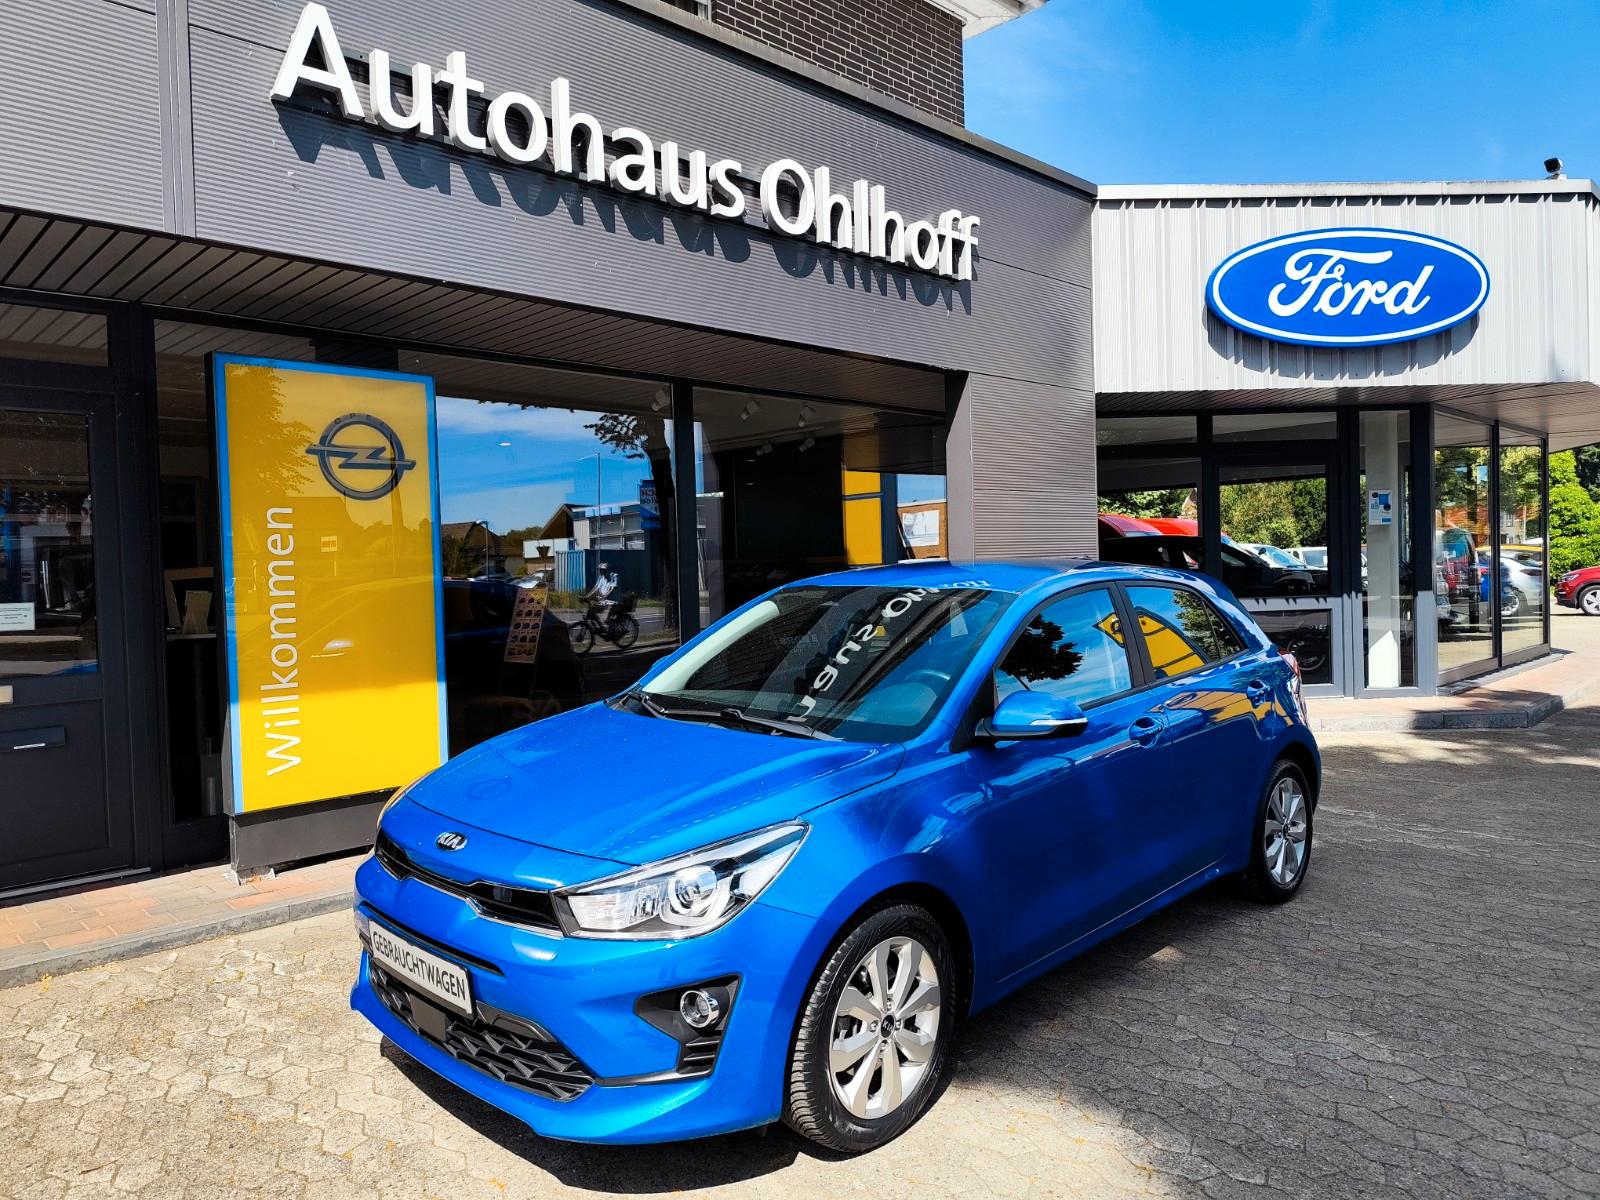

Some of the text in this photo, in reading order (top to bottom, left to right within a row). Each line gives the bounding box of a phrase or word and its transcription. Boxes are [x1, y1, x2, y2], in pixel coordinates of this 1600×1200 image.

[270, 1, 981, 281] Autohaus Ohlhoff
[1268, 248, 1435, 317] Ford
[260, 506, 303, 777] Willkommen
[437, 832, 462, 849] KIA
[372, 930, 467, 1001] GEBRAUCHTWAGEN
